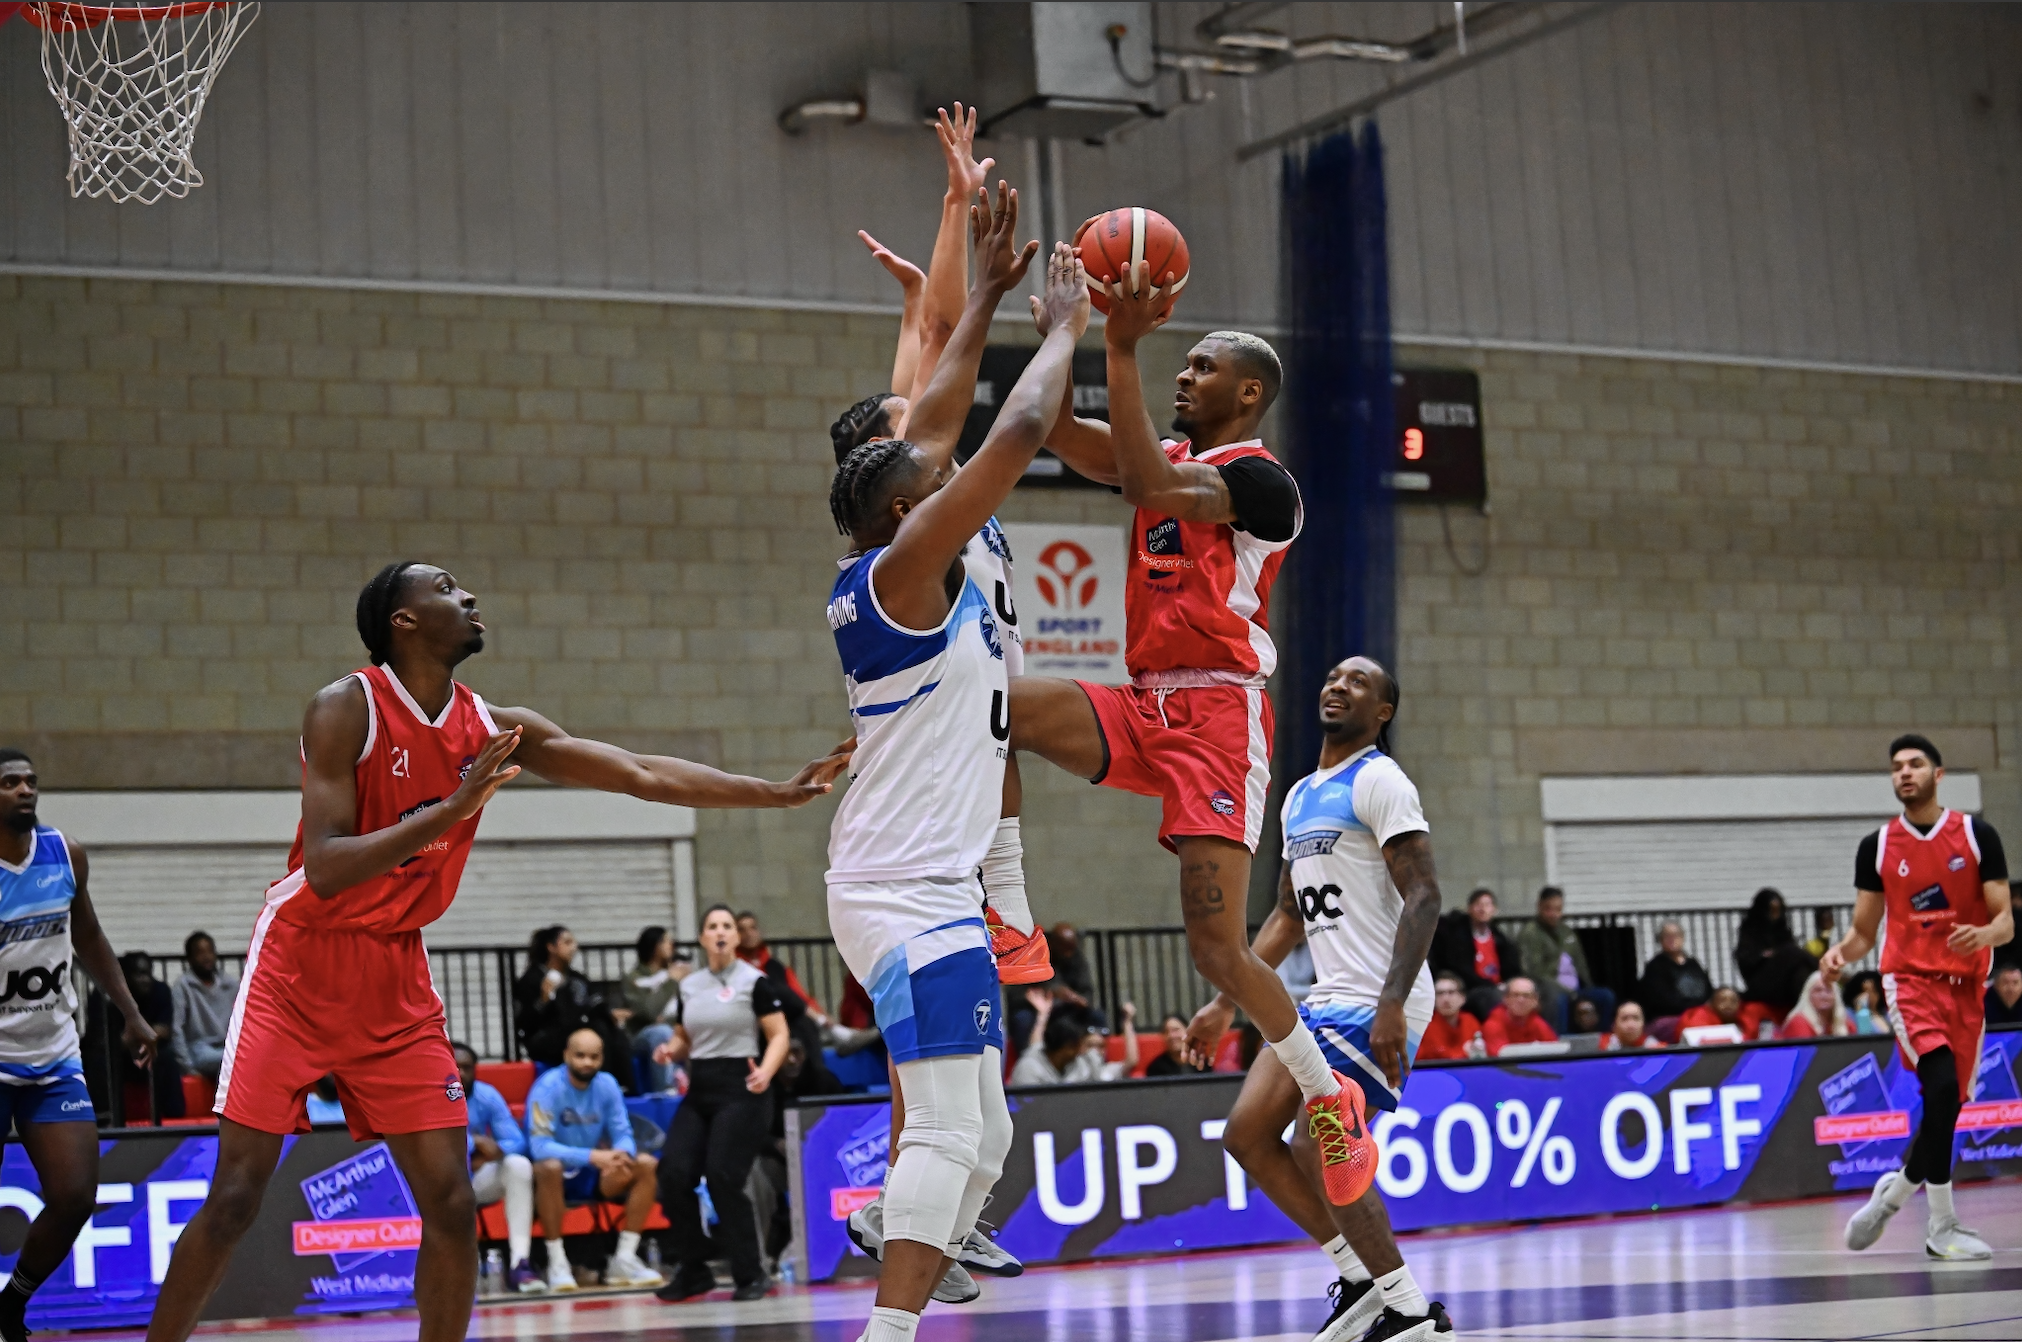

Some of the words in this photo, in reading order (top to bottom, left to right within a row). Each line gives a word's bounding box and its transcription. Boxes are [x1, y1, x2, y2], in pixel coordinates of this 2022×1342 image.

[1404, 428, 1423, 460] 3
[1038, 617, 1102, 635] SPORT
[391, 746, 411, 779] 21
[1898, 859, 1910, 878] 6
[1033, 1124, 1178, 1226] UP
[1371, 1097, 1577, 1198] 60%
[1599, 1083, 1762, 1180] OFF
[308, 1154, 387, 1201] McArthur
[316, 1192, 359, 1220] Glen
[301, 1227, 377, 1250] Designer
